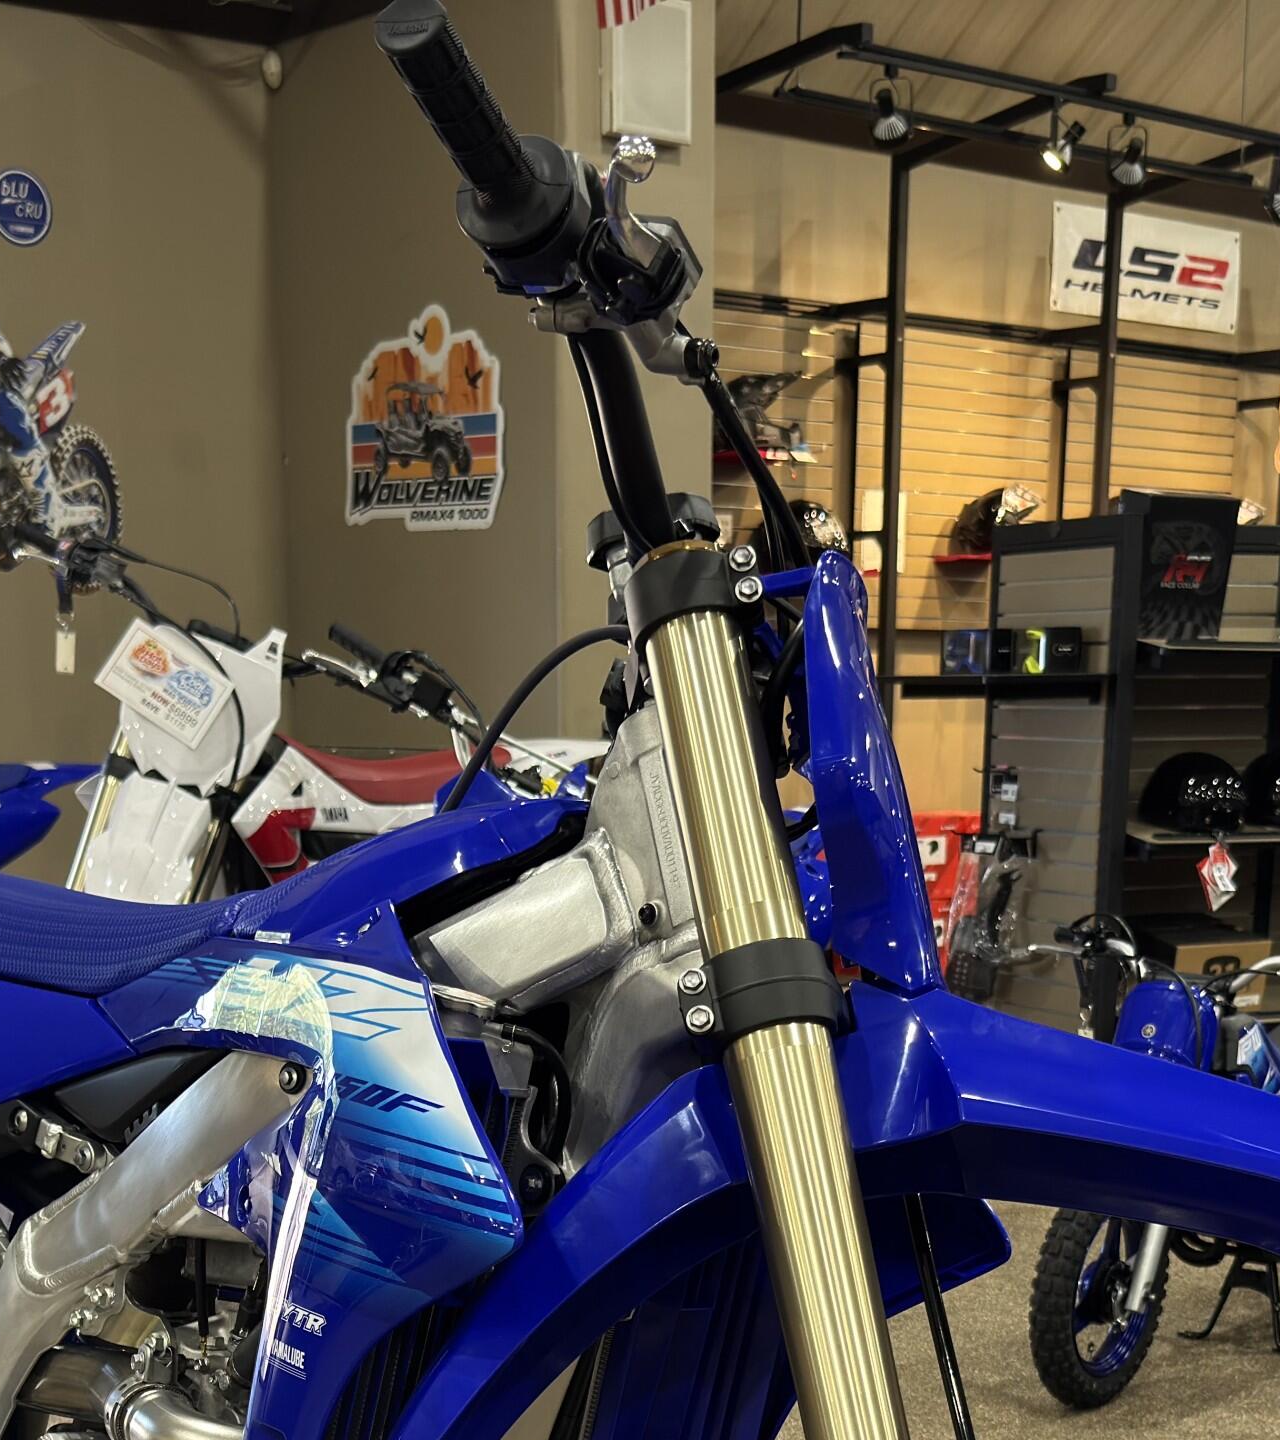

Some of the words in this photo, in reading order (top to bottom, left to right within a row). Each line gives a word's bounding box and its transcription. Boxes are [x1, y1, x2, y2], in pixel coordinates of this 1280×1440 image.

[1073, 238, 1230, 292] LS2
[37, 371, 71, 428] 3
[351, 471, 497, 517] WOLVERINE
[410, 508, 455, 523] RMAX4
[458, 506, 490, 521] 1000
[150, 690, 170, 709] NOW
